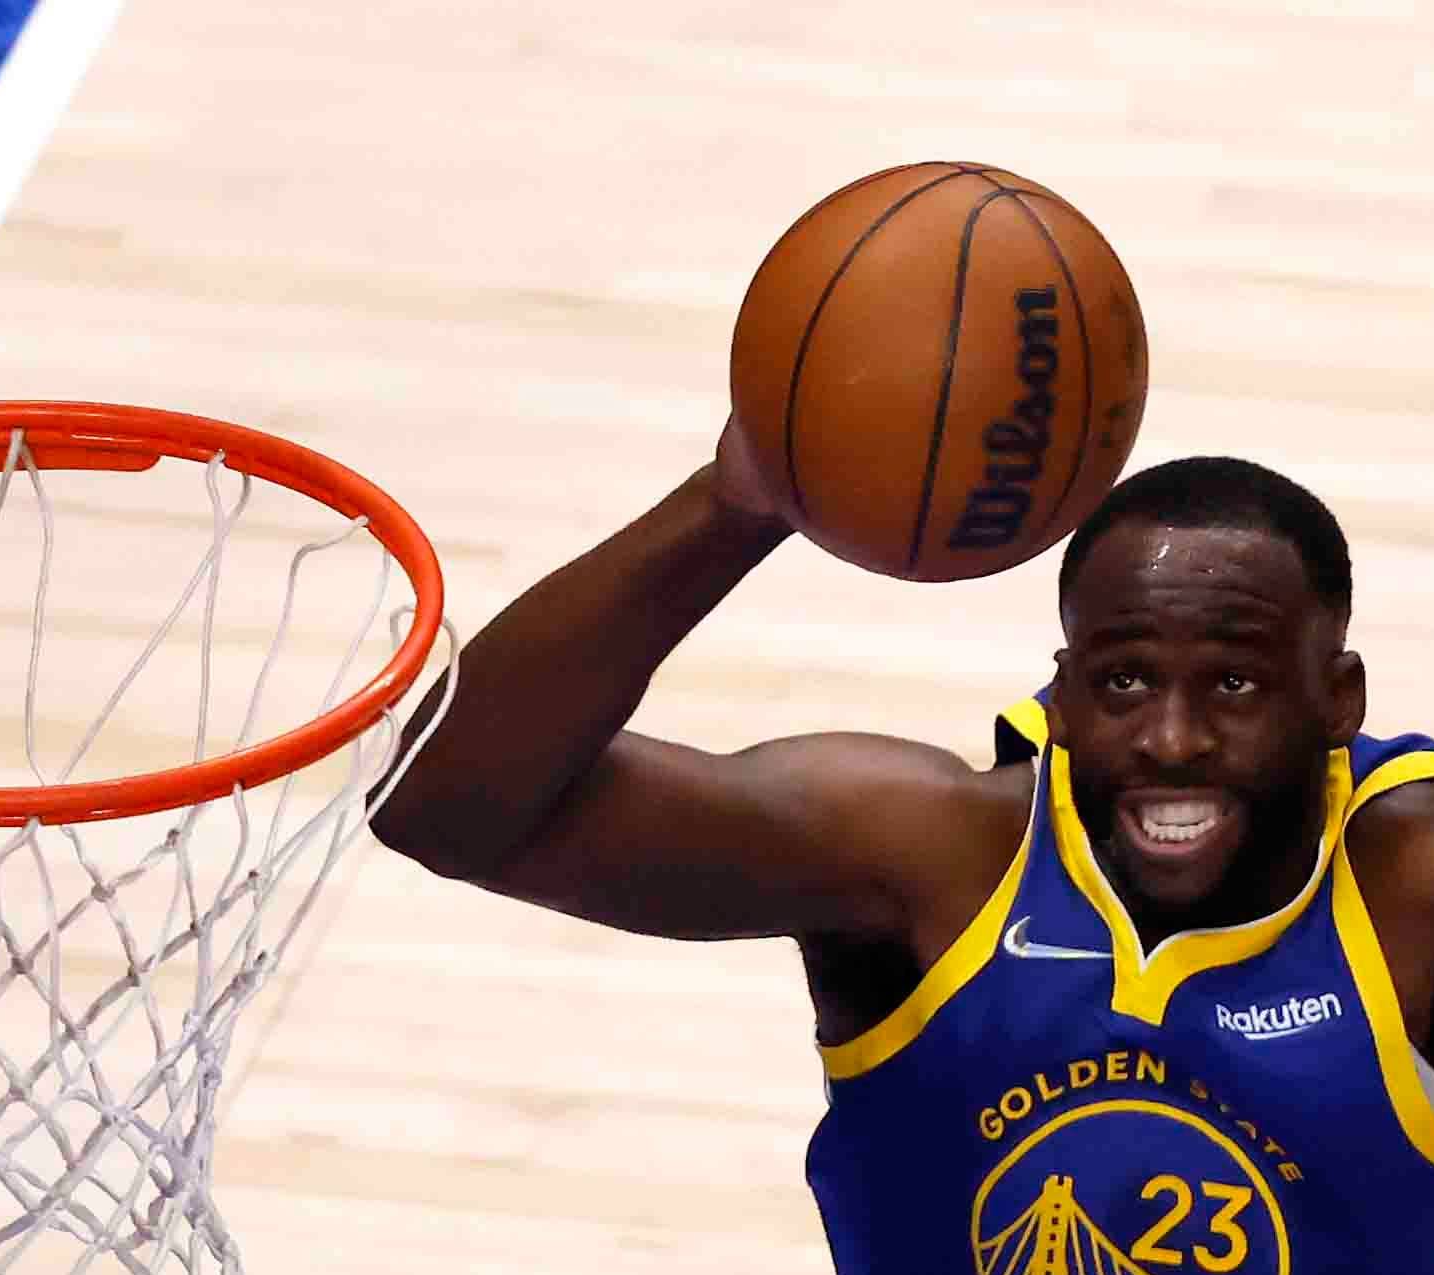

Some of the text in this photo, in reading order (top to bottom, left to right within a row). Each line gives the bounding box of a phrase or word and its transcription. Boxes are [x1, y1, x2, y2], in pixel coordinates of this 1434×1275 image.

[948, 284, 1059, 551] Wilson
[1214, 991, 1343, 1038] Rakuten
[979, 1049, 1305, 1184] GOLDEN SATE
[1129, 1174, 1254, 1274] 23
